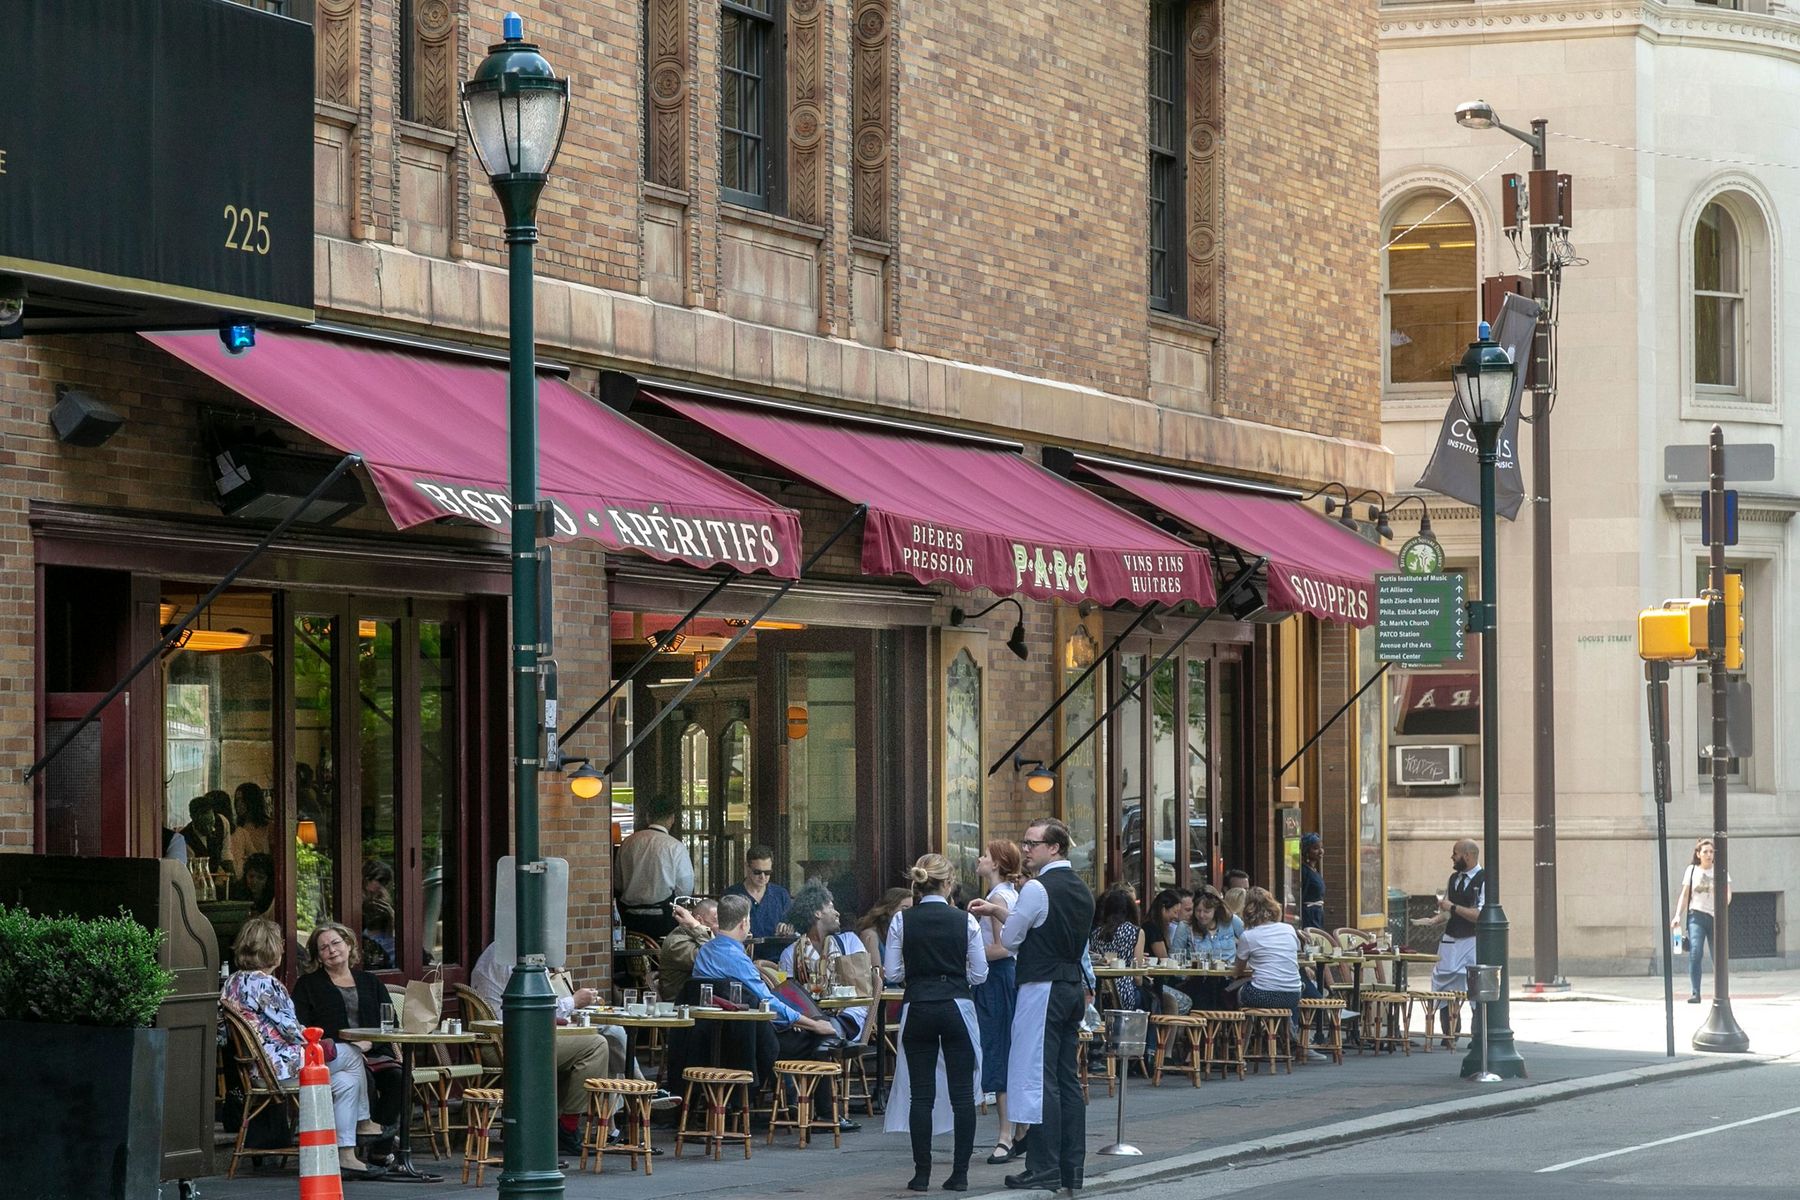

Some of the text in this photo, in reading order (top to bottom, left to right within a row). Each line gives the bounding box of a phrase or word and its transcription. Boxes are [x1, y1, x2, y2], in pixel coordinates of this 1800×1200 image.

[224, 204, 270, 255] 225
[1447, 438, 1479, 455] INSTITUT
[1451, 419, 1512, 457] CUIS
[416, 482, 780, 567] BISTO APÉRITIFS
[913, 522, 963, 551] BIÈRES
[904, 548, 974, 576] PRESSION
[1124, 554, 1184, 572] VINS FINS
[1290, 574, 1368, 620] SOUPERS
